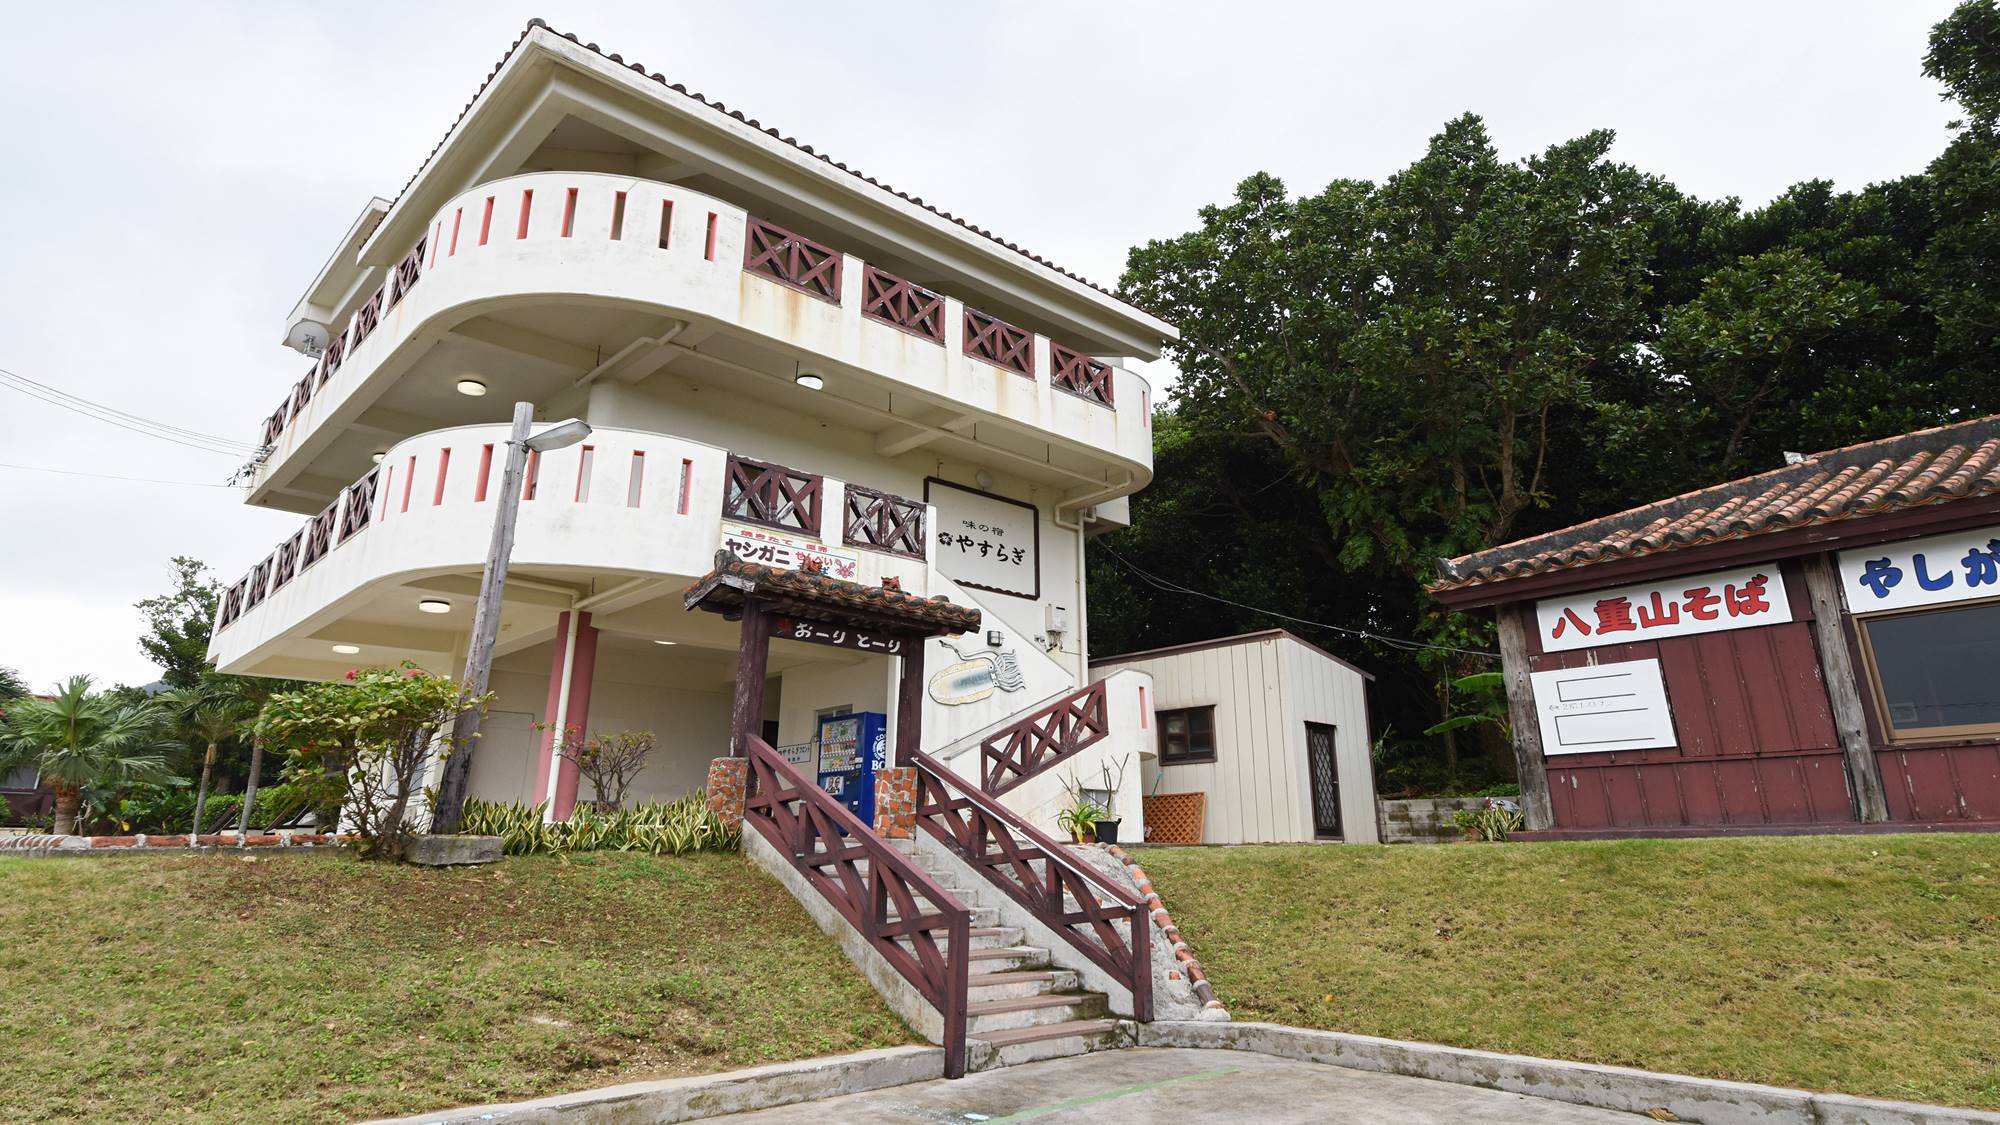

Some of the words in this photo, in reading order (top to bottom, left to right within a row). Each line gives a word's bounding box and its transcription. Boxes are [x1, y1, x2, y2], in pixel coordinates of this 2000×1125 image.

[725, 538, 790, 565] ヤシガニ
[956, 534, 1025, 565] やすらぎ
[1859, 538, 2000, 599] やしが
[1552, 573, 1771, 640] 八重山そば
